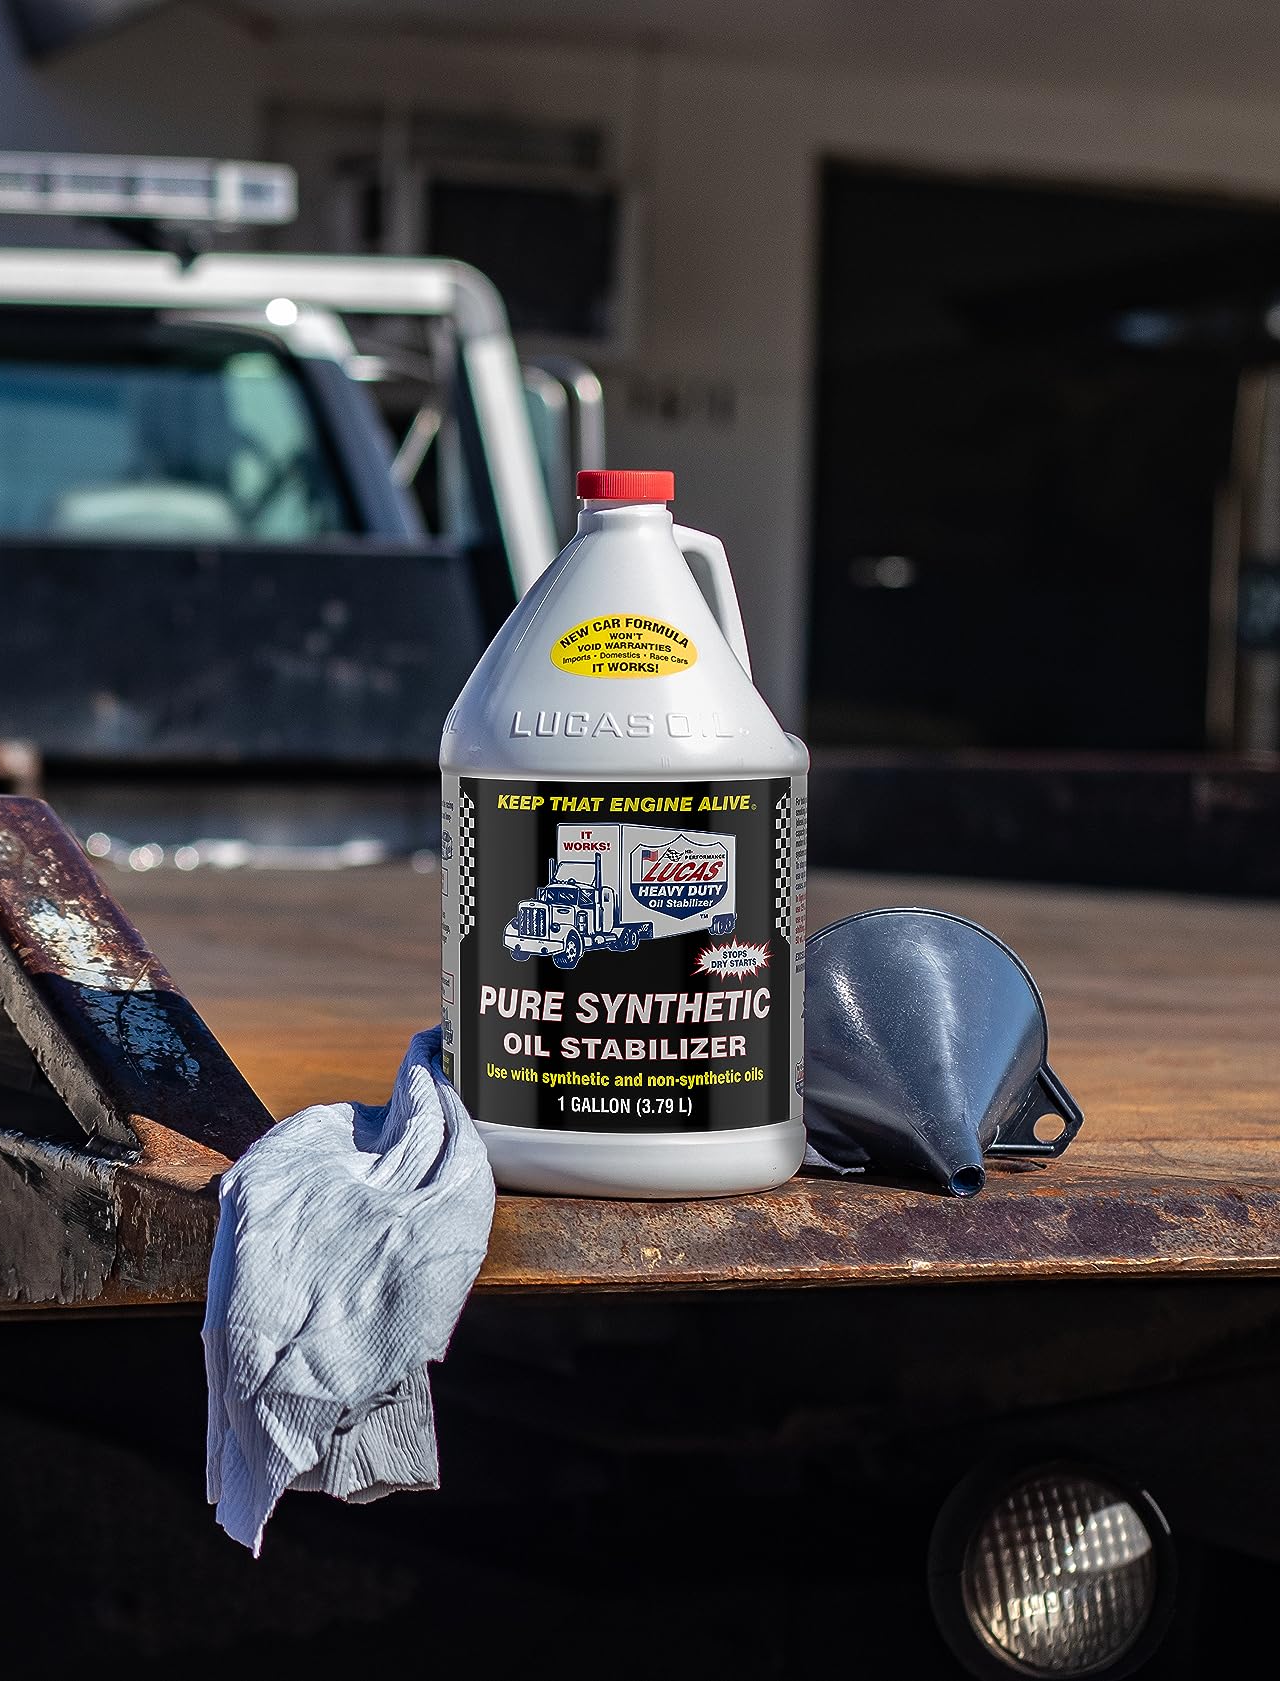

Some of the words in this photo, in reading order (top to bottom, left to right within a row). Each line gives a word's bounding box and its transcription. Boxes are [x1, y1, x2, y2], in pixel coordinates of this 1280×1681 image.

[560, 626, 589, 648] NEW
[592, 618, 620, 632] CAR
[625, 618, 689, 648] FORMULA
[609, 632, 643, 640] WON'T
[577, 642, 601, 652] VOID
[604, 642, 672, 652] WARRANTIES
[562, 654, 591, 664] Imports
[600, 651, 640, 659] Domestics
[649, 652, 669, 662] Race
[670, 655, 688, 665] Cars
[592, 663, 604, 673] IT
[607, 662, 659, 674] WORKS!
[509, 710, 654, 739] LUCAS
[497, 794, 545, 811] KEEP
[550, 797, 604, 812] THAT
[609, 797, 693, 812] ENGINE
[580, 831, 592, 839] IT
[563, 842, 611, 851] WORKS!
[641, 861, 724, 882] LUCAS
[638, 885, 685, 897] HEAVY
[687, 885, 723, 896] DUTY
[648, 899, 663, 908] Oil
[666, 898, 714, 908] Stabilizer
[722, 949, 747, 959] STOPS
[711, 960, 728, 969] DRY
[729, 958, 757, 968] STARTS
[479, 985, 564, 1022] PURE
[575, 987, 771, 1025] SYNTHETIC
[503, 1032, 550, 1057] OIL
[560, 1034, 747, 1060] STABILIZER
[486, 1062, 508, 1079] Use
[510, 1067, 538, 1083] with
[542, 1070, 610, 1088] synthetic
[614, 1072, 643, 1087] and
[647, 1068, 742, 1090] non-synthetic
[744, 1066, 765, 1082] oils
[557, 1096, 565, 1112] 1
[571, 1097, 631, 1115] GALLON
[636, 1098, 674, 1118] (3.79
[678, 1097, 693, 1117] L)
